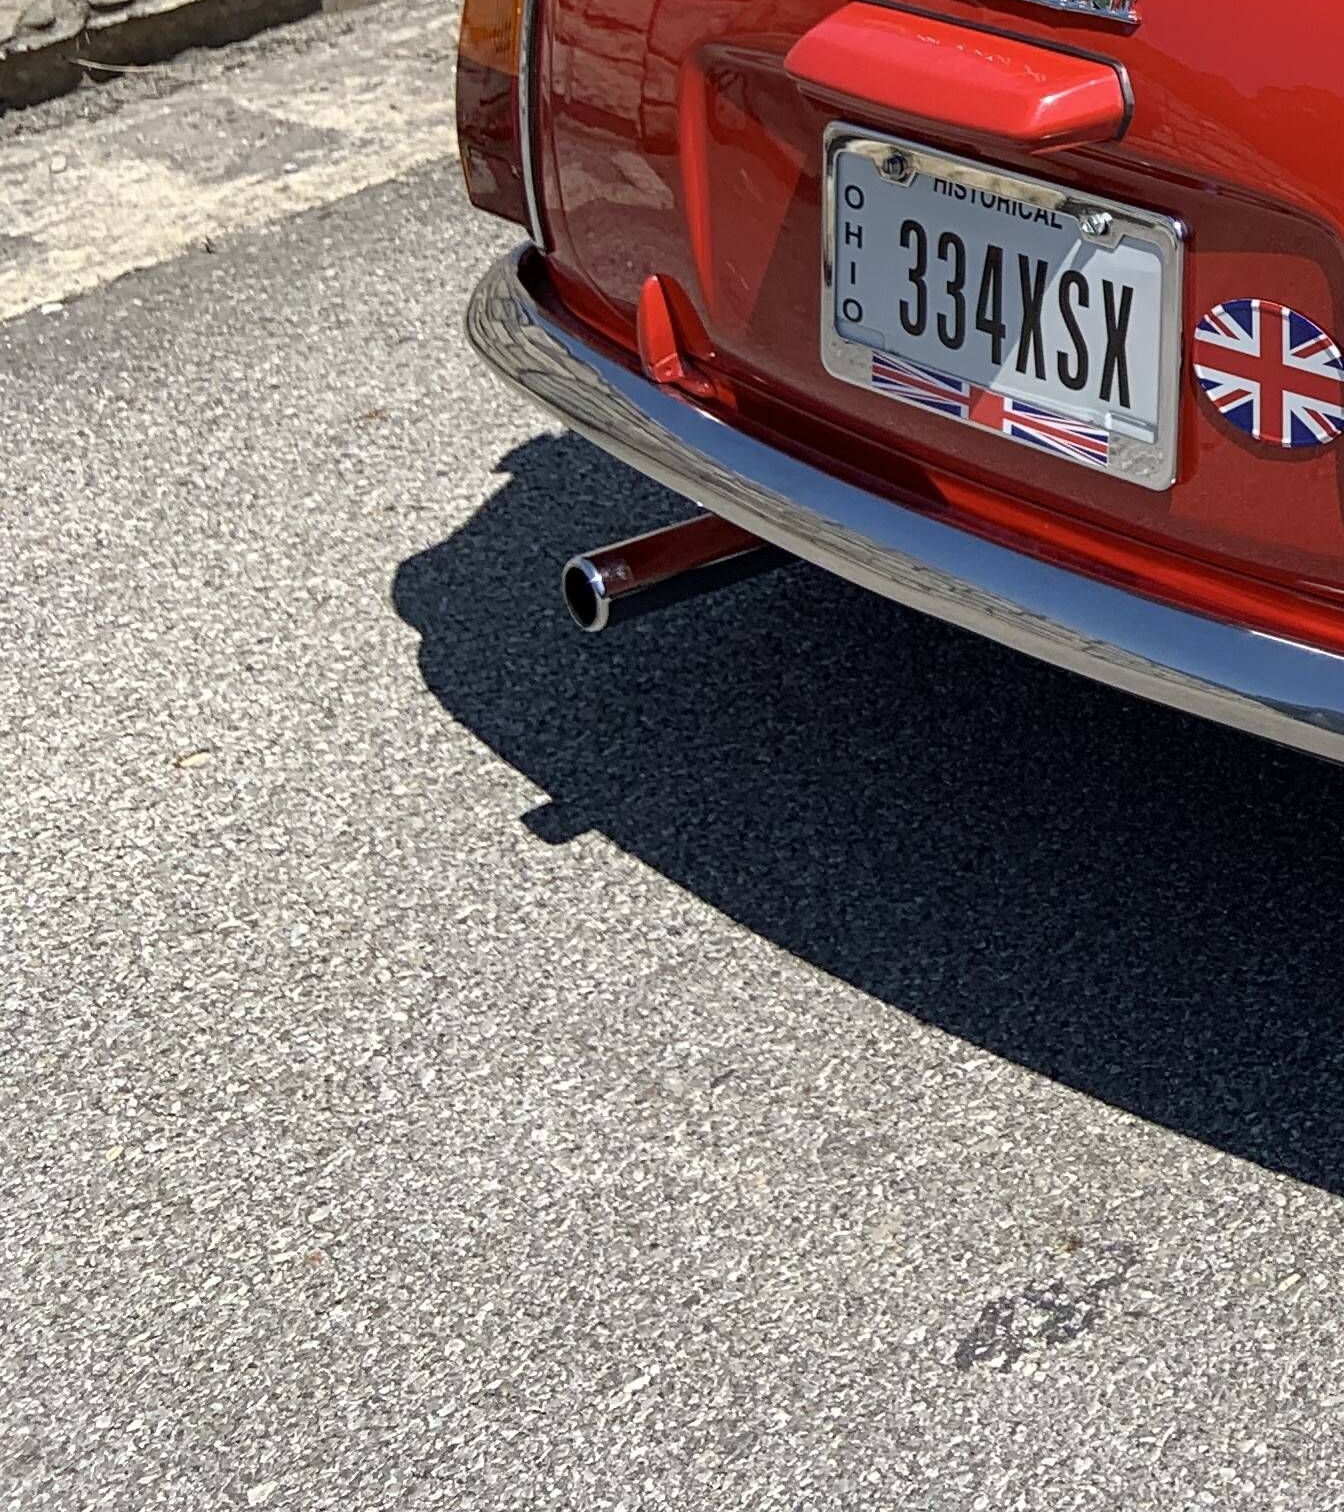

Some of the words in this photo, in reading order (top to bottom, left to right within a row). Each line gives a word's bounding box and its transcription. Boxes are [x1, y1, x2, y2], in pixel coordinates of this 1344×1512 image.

[843, 184, 865, 324] OHIO
[932, 178, 1063, 230] HISTORICAL
[899, 219, 1134, 410] 334XSX
